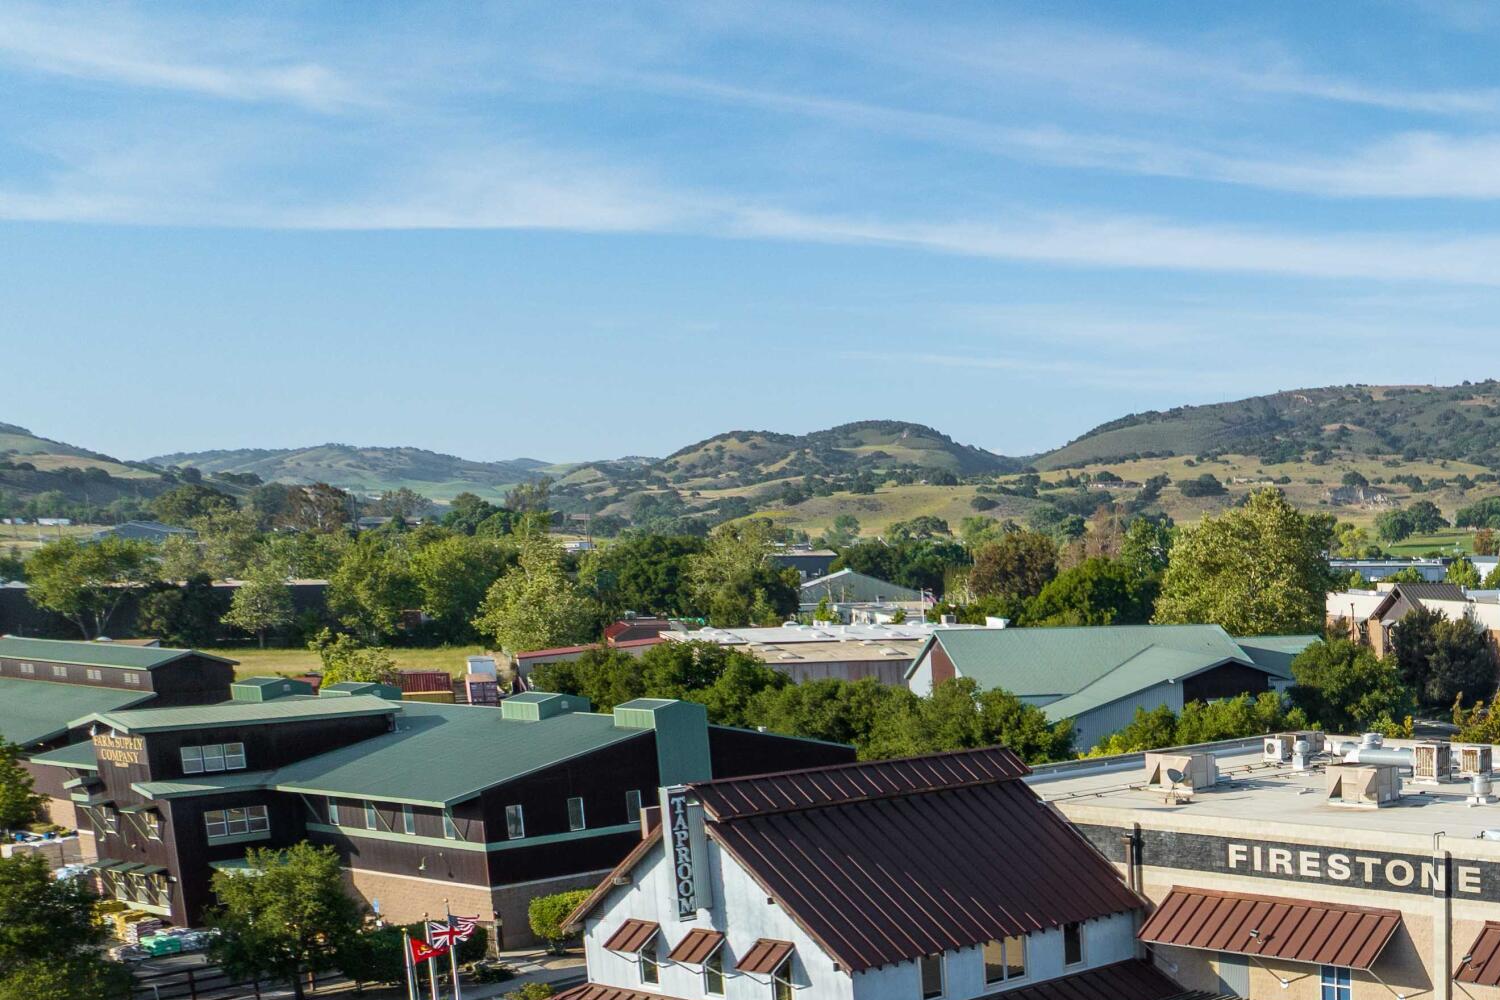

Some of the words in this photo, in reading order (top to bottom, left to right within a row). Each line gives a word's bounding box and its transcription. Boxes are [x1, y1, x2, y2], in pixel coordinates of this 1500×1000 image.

[101, 749, 138, 763] COMPANY
[671, 795, 697, 914] TAPROOM
[1228, 843, 1482, 894] FIRESTONE
